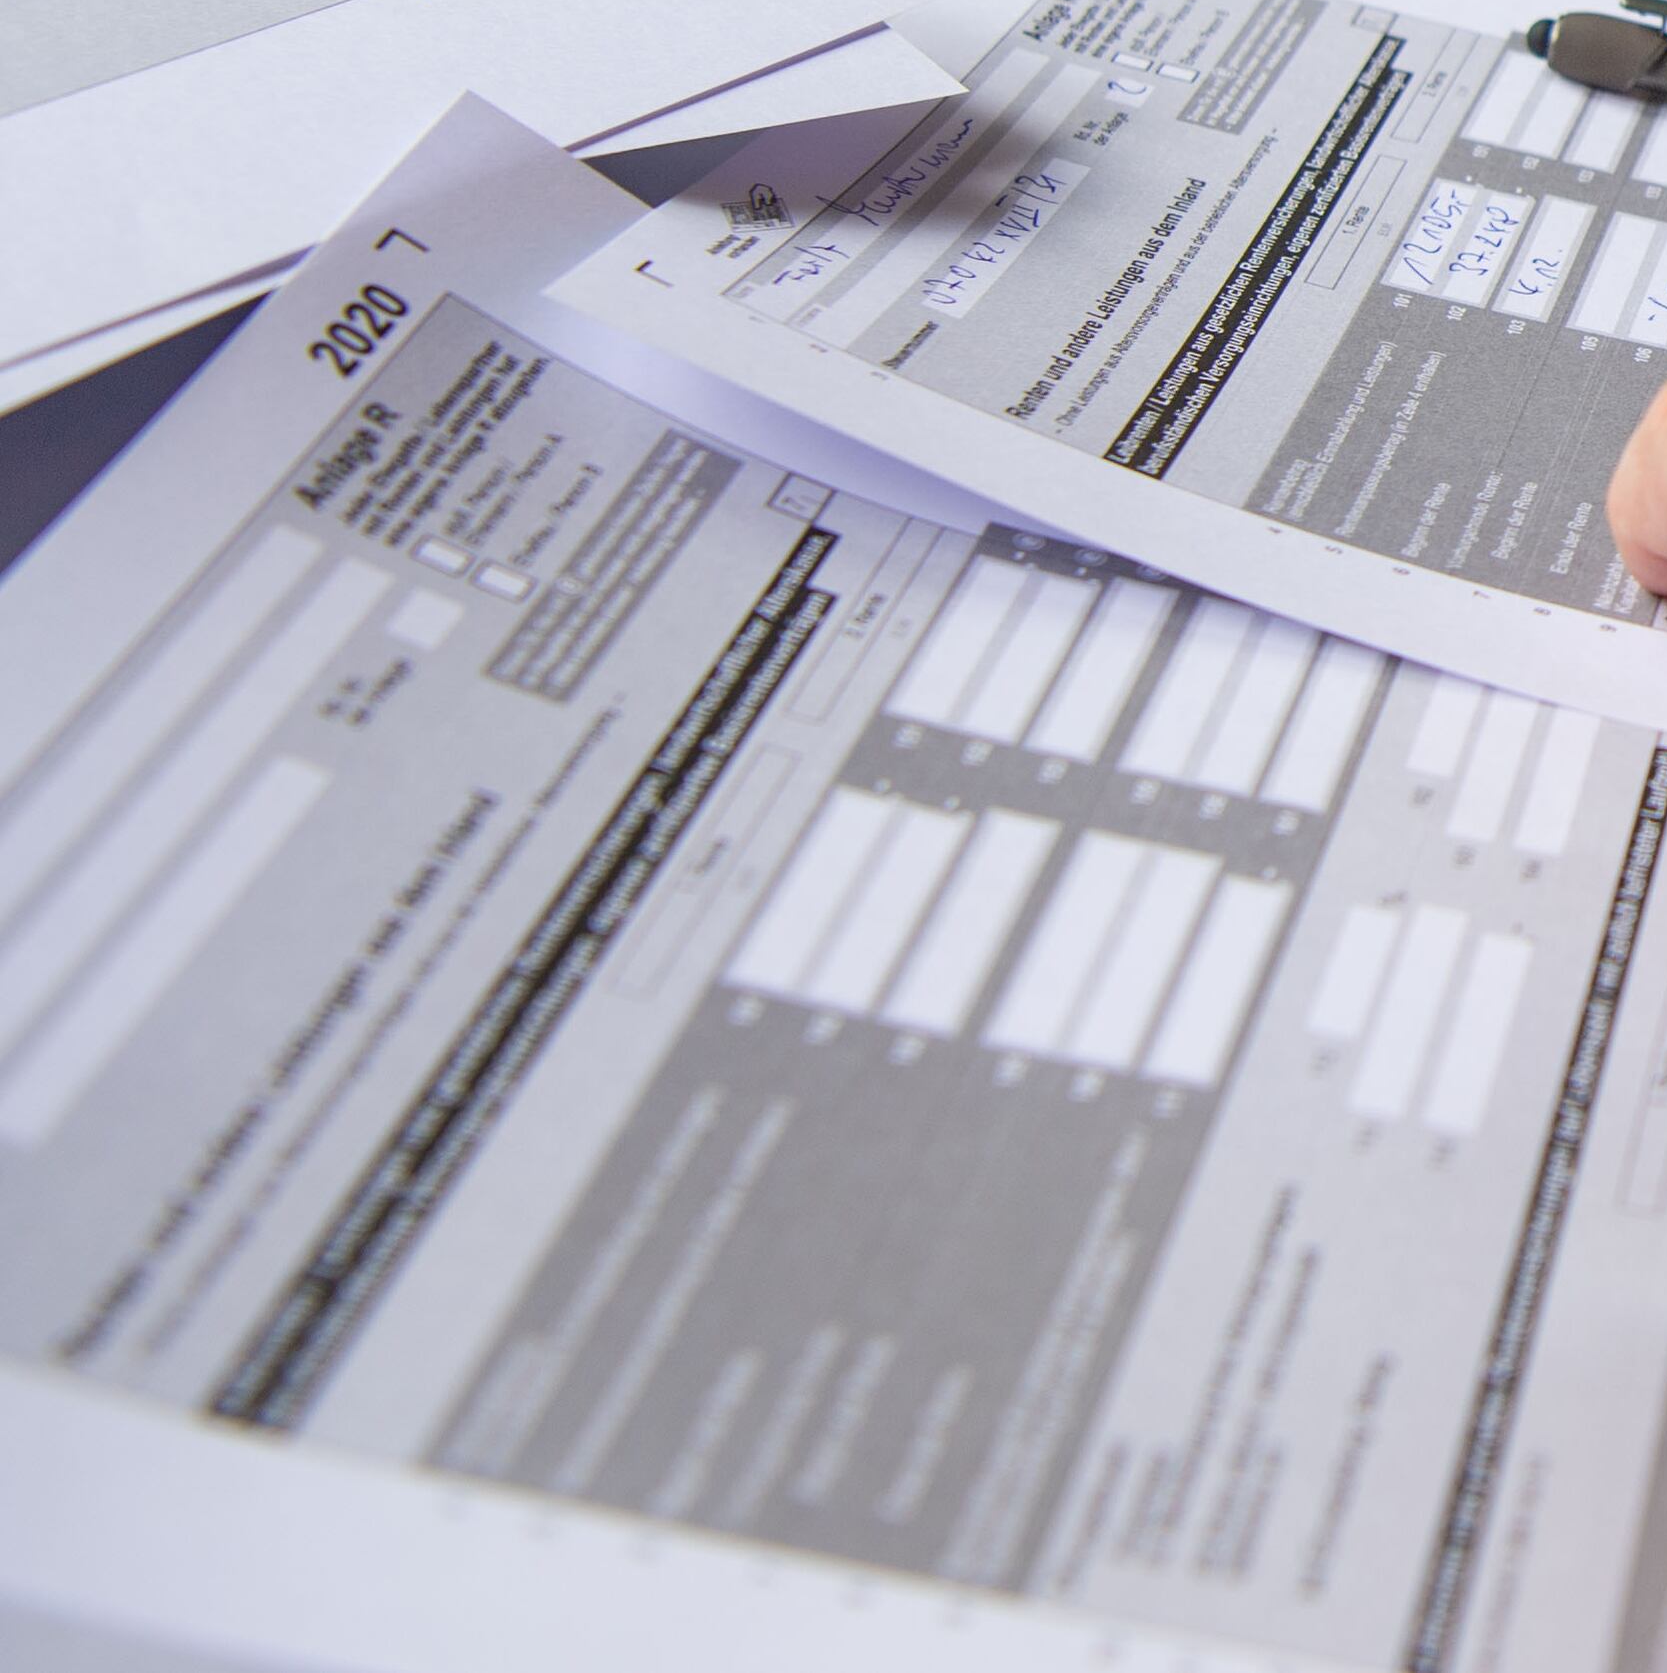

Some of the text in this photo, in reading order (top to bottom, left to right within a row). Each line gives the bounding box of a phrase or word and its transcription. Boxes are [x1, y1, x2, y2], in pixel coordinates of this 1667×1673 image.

[1344, 205, 1371, 228] Rente
[1191, 231, 1209, 246] der
[1182, 244, 1202, 260] aus
[1173, 257, 1192, 275] und
[1004, 177, 1207, 420] Renten und andere Leistungen aus dem Inland
[1392, 292, 1413, 309] 101
[1108, 410, 1162, 465] Leibrenten
[1148, 350, 1202, 407] Leistungen
[1190, 331, 1215, 353] aus
[1203, 271, 1254, 335] gesetzlichen
[1229, 169, 1321, 273] Rentenversicherungen,
[1137, 382, 1216, 476] berufsständischen
[1194, 254, 1310, 383] Versorgungseinrichtungen,
[1285, 214, 1320, 254] eigenen
[1309, 158, 1355, 217] zertifizierten
[1446, 304, 1468, 322] 102
[309, 283, 410, 378] 2020
[1506, 318, 1527, 335] 103
[1580, 334, 1600, 352] 105
[1633, 346, 1653, 363] 106
[1103, 353, 1123, 370] aus
[1360, 340, 1399, 389] Leistungen)
[1353, 386, 1371, 406] und
[1395, 398, 1421, 422] Zeile
[1413, 350, 1447, 393] enthalten)
[295, 402, 399, 509] Anlage R
[1423, 481, 1452, 510] Rente
[1475, 470, 1504, 502] Rente:
[1419, 508, 1438, 526] der
[1490, 481, 1539, 561] Beginn der Rente
[1548, 501, 1594, 575] Ende der Rente
